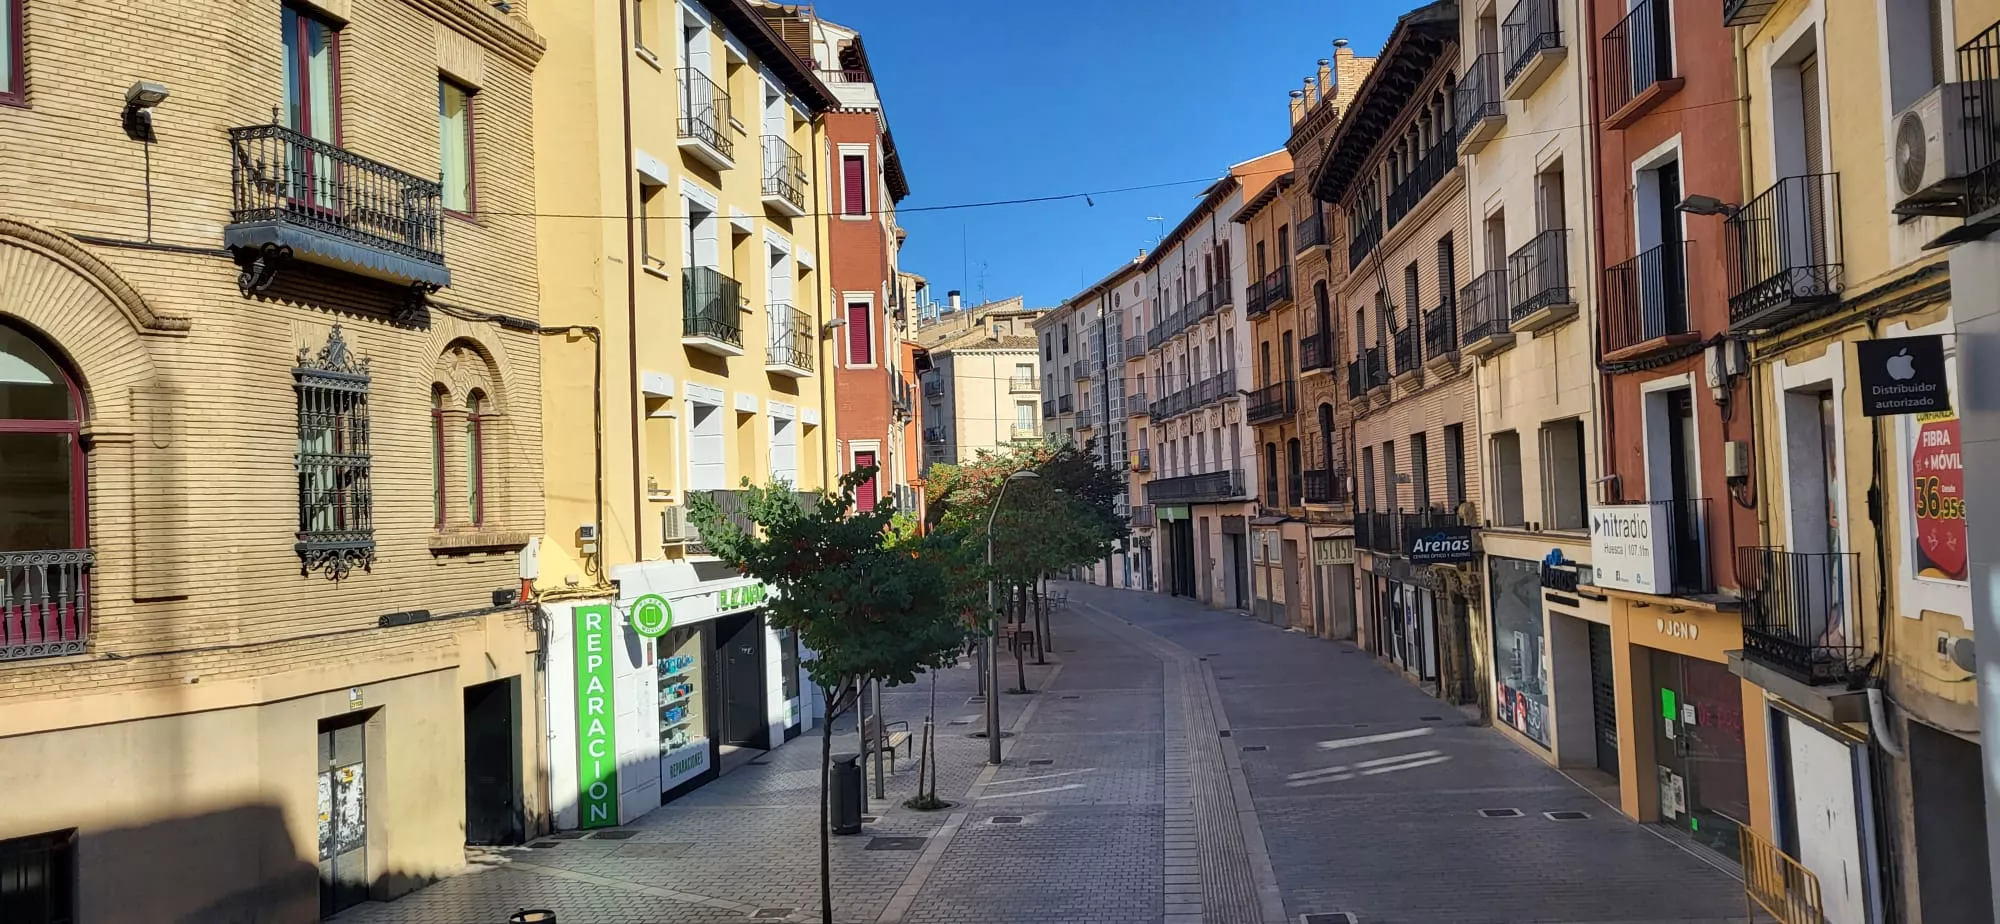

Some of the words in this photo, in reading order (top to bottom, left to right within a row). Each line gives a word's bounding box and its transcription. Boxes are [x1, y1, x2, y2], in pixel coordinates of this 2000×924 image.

[1872, 382, 1937, 395] Distribuidor
[1875, 397, 1934, 409] autorizado
[1923, 429, 1951, 447] FIBRA
[1602, 512, 1648, 539] hitradio
[1413, 538, 1470, 553] Arenas
[1666, 619, 1689, 640] JCN
[585, 612, 608, 822] REPARACION
